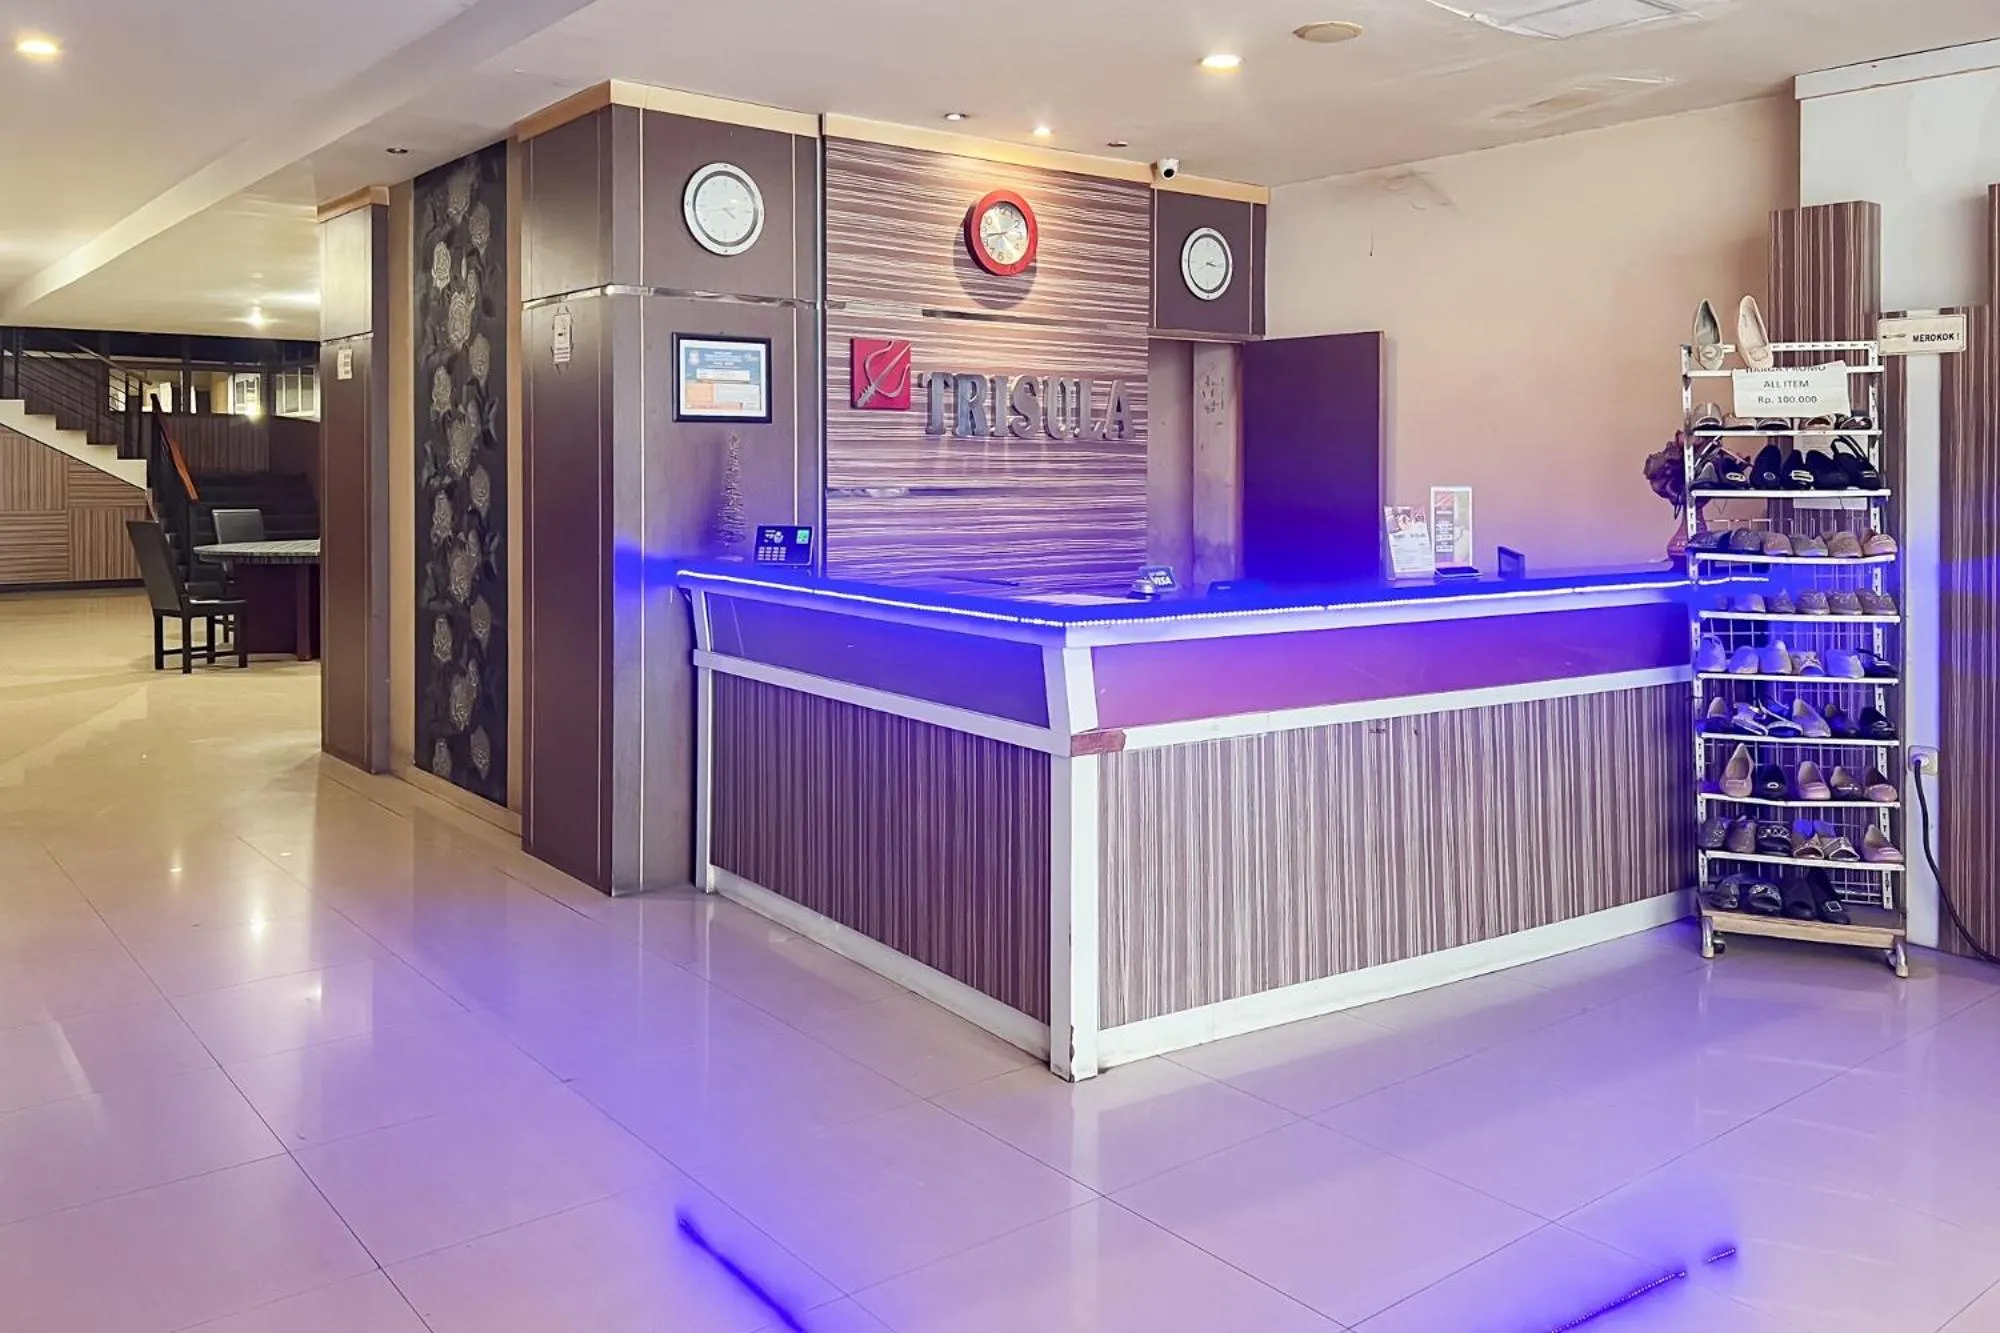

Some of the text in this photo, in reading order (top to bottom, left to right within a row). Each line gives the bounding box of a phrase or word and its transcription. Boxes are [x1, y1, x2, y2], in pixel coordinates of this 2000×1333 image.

[1912, 332, 1955, 343] MEROKOK
[1763, 380, 1809, 389] ALL ITEM
[1758, 396, 1817, 405] Rp. 100.000
[917, 372, 1136, 440] TRISULA
